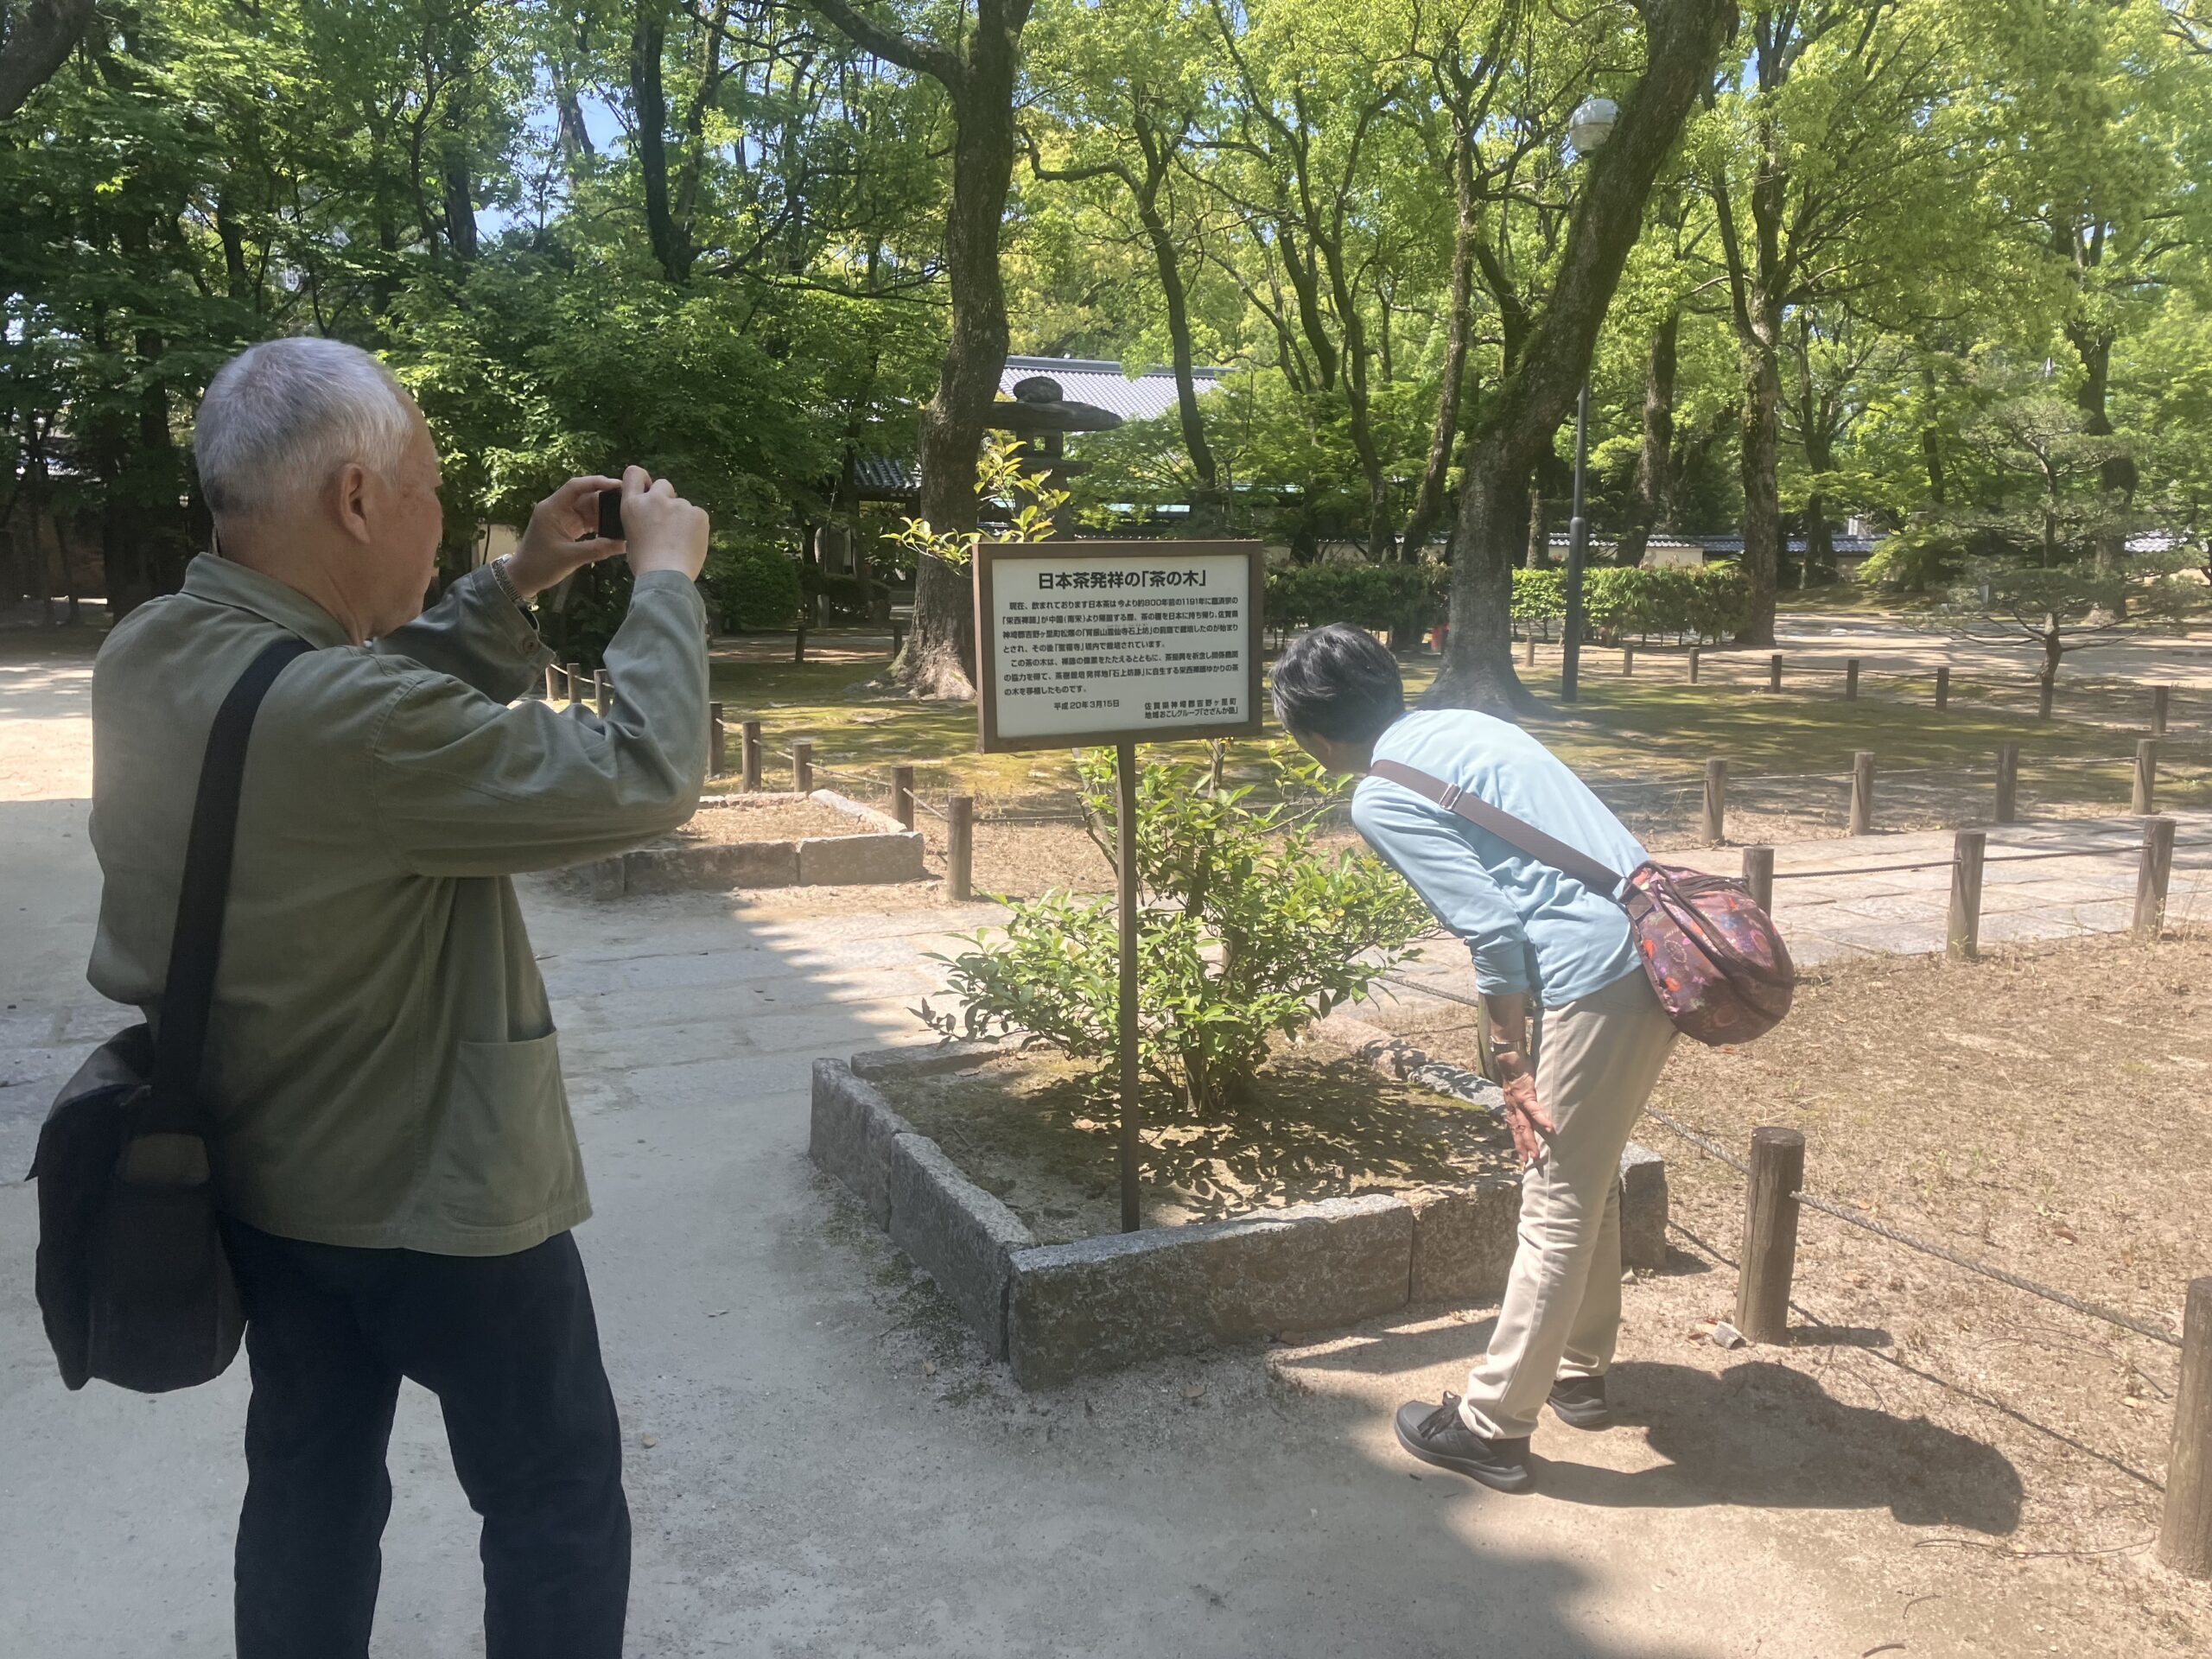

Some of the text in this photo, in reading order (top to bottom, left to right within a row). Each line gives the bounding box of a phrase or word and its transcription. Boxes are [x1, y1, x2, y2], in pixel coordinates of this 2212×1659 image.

[1038, 569, 1206, 590] 日本茶発祥の「茶の木」
[1053, 699, 1120, 711] 平成20年3月15日
